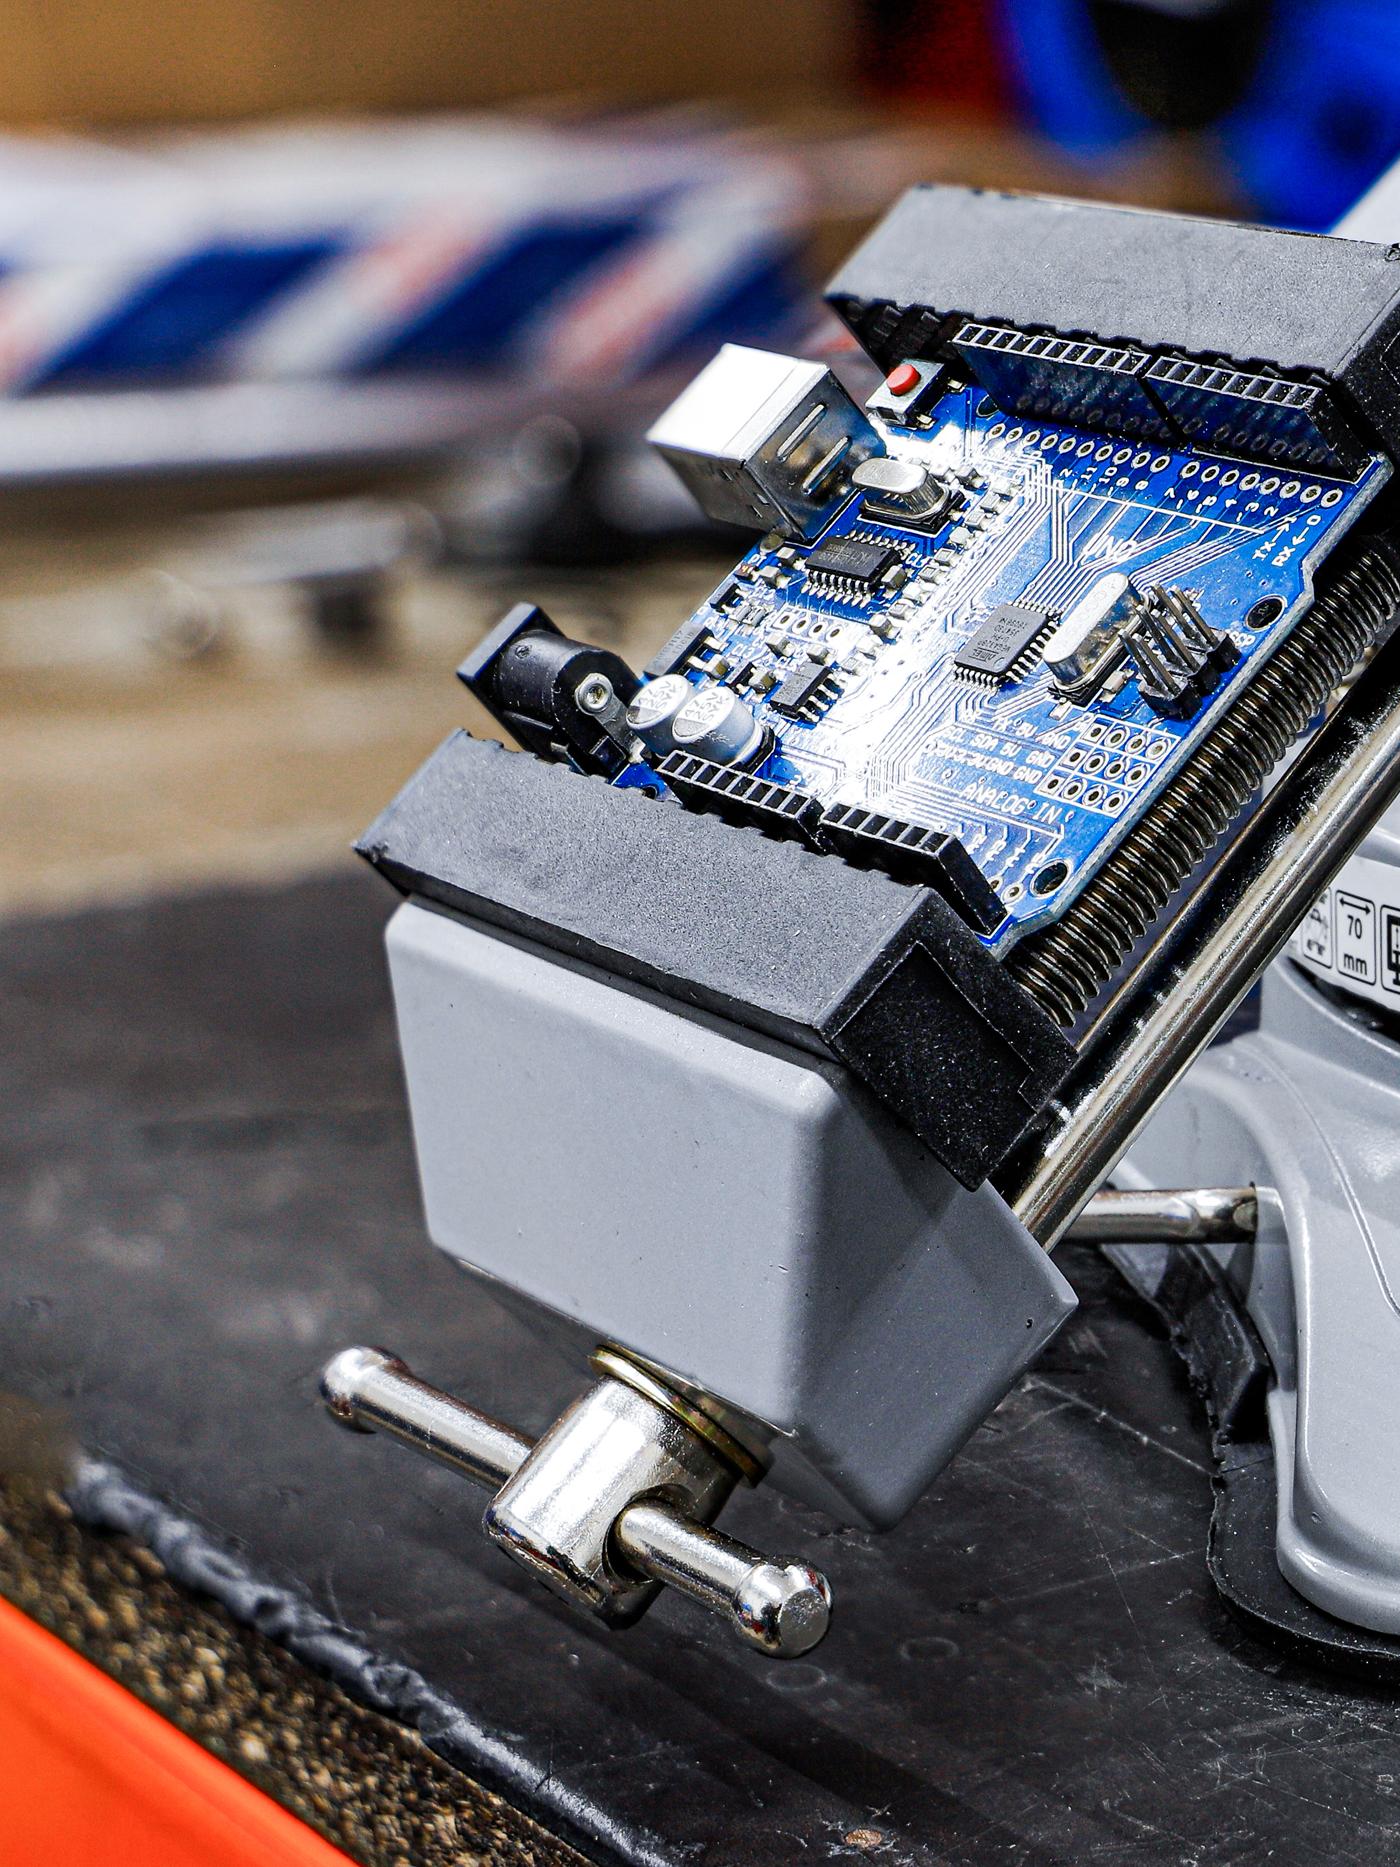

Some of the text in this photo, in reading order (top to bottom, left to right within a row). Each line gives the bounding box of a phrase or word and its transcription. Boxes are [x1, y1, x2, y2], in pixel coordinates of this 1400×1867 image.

[1264, 506, 1279, 517] 2
[970, 733, 999, 751] SDA
[1026, 750, 1056, 768] GND
[1013, 766, 1043, 784] GND
[962, 781, 1062, 824] ANALOG IN
[1347, 914, 1362, 939] 70
[1343, 953, 1367, 975] mm
